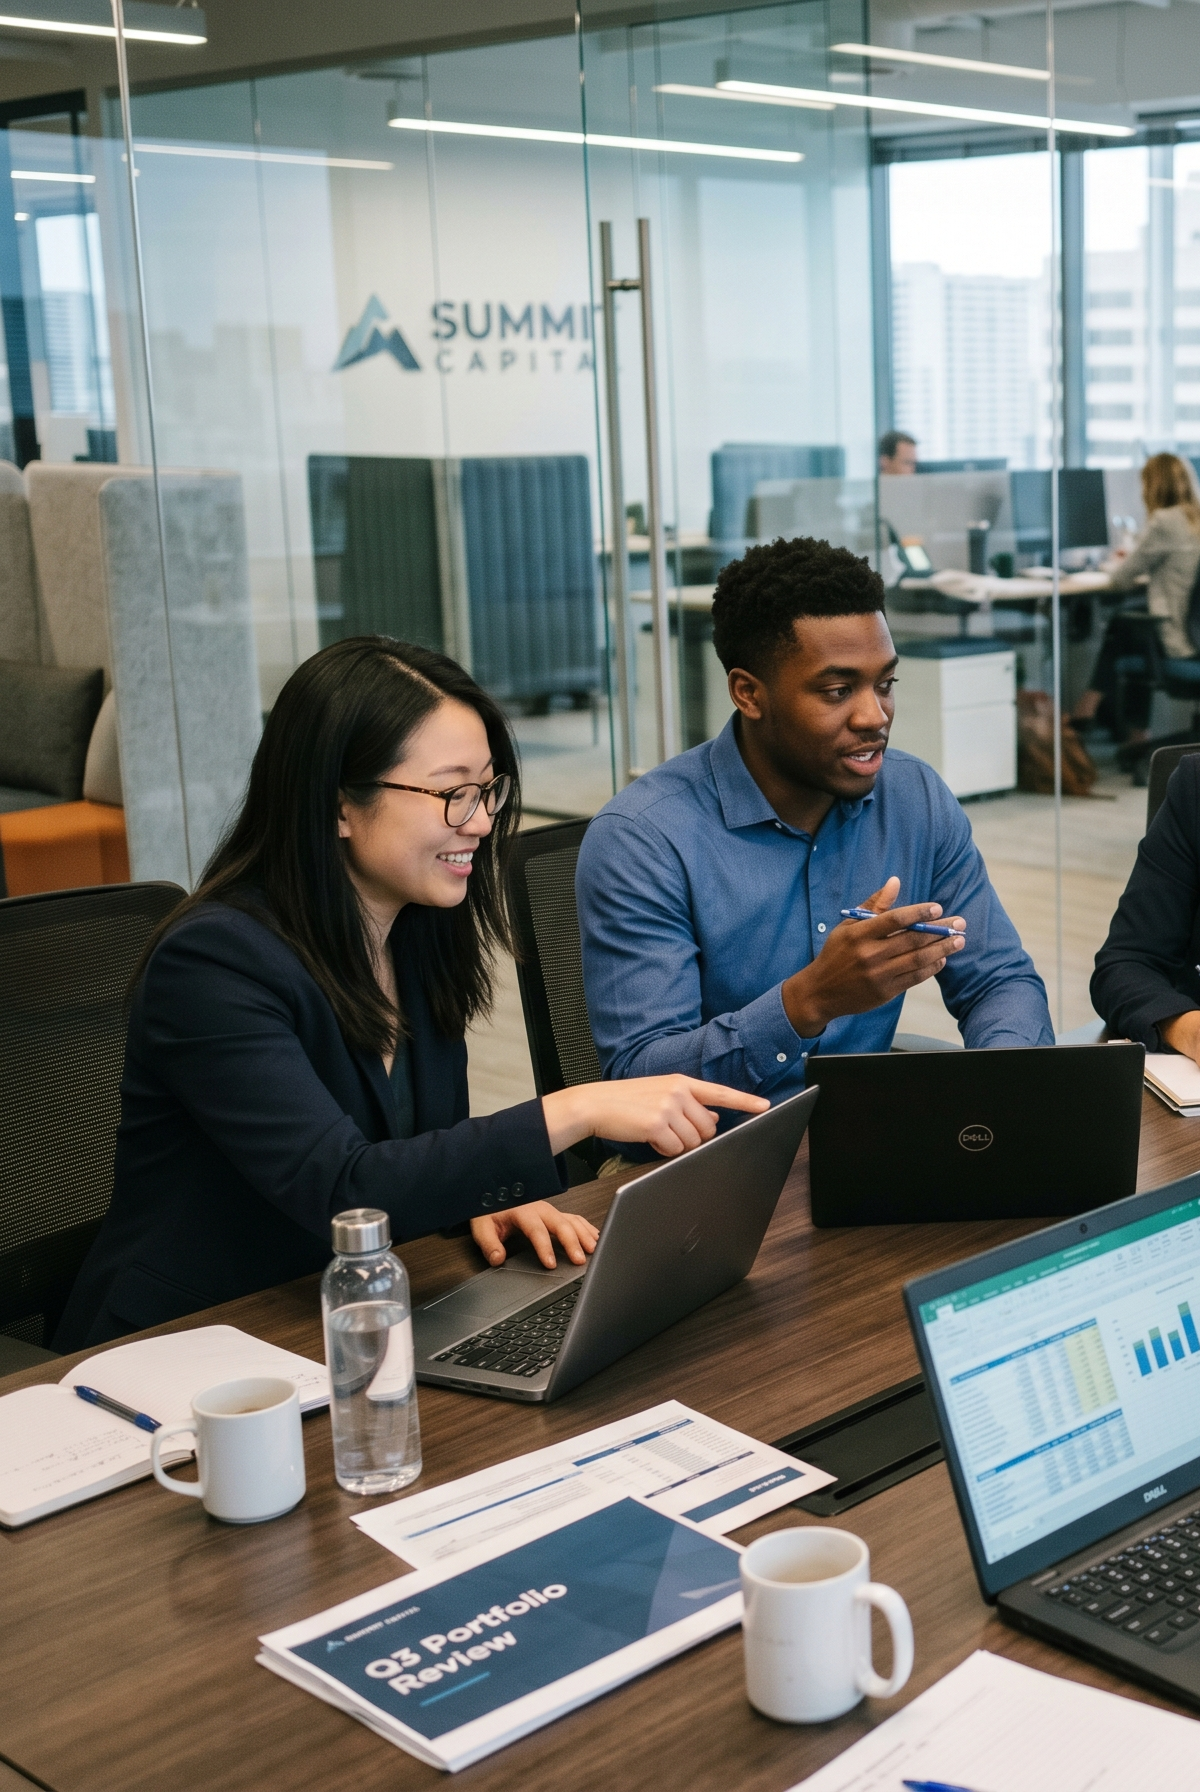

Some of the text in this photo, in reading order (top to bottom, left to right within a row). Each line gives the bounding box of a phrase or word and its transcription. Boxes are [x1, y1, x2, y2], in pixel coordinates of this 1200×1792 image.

[435, 350, 620, 373] CAPITA
[364, 1646, 422, 1679] Q3
[419, 1583, 568, 1655] Portfolio
[387, 1630, 518, 1696] Review
